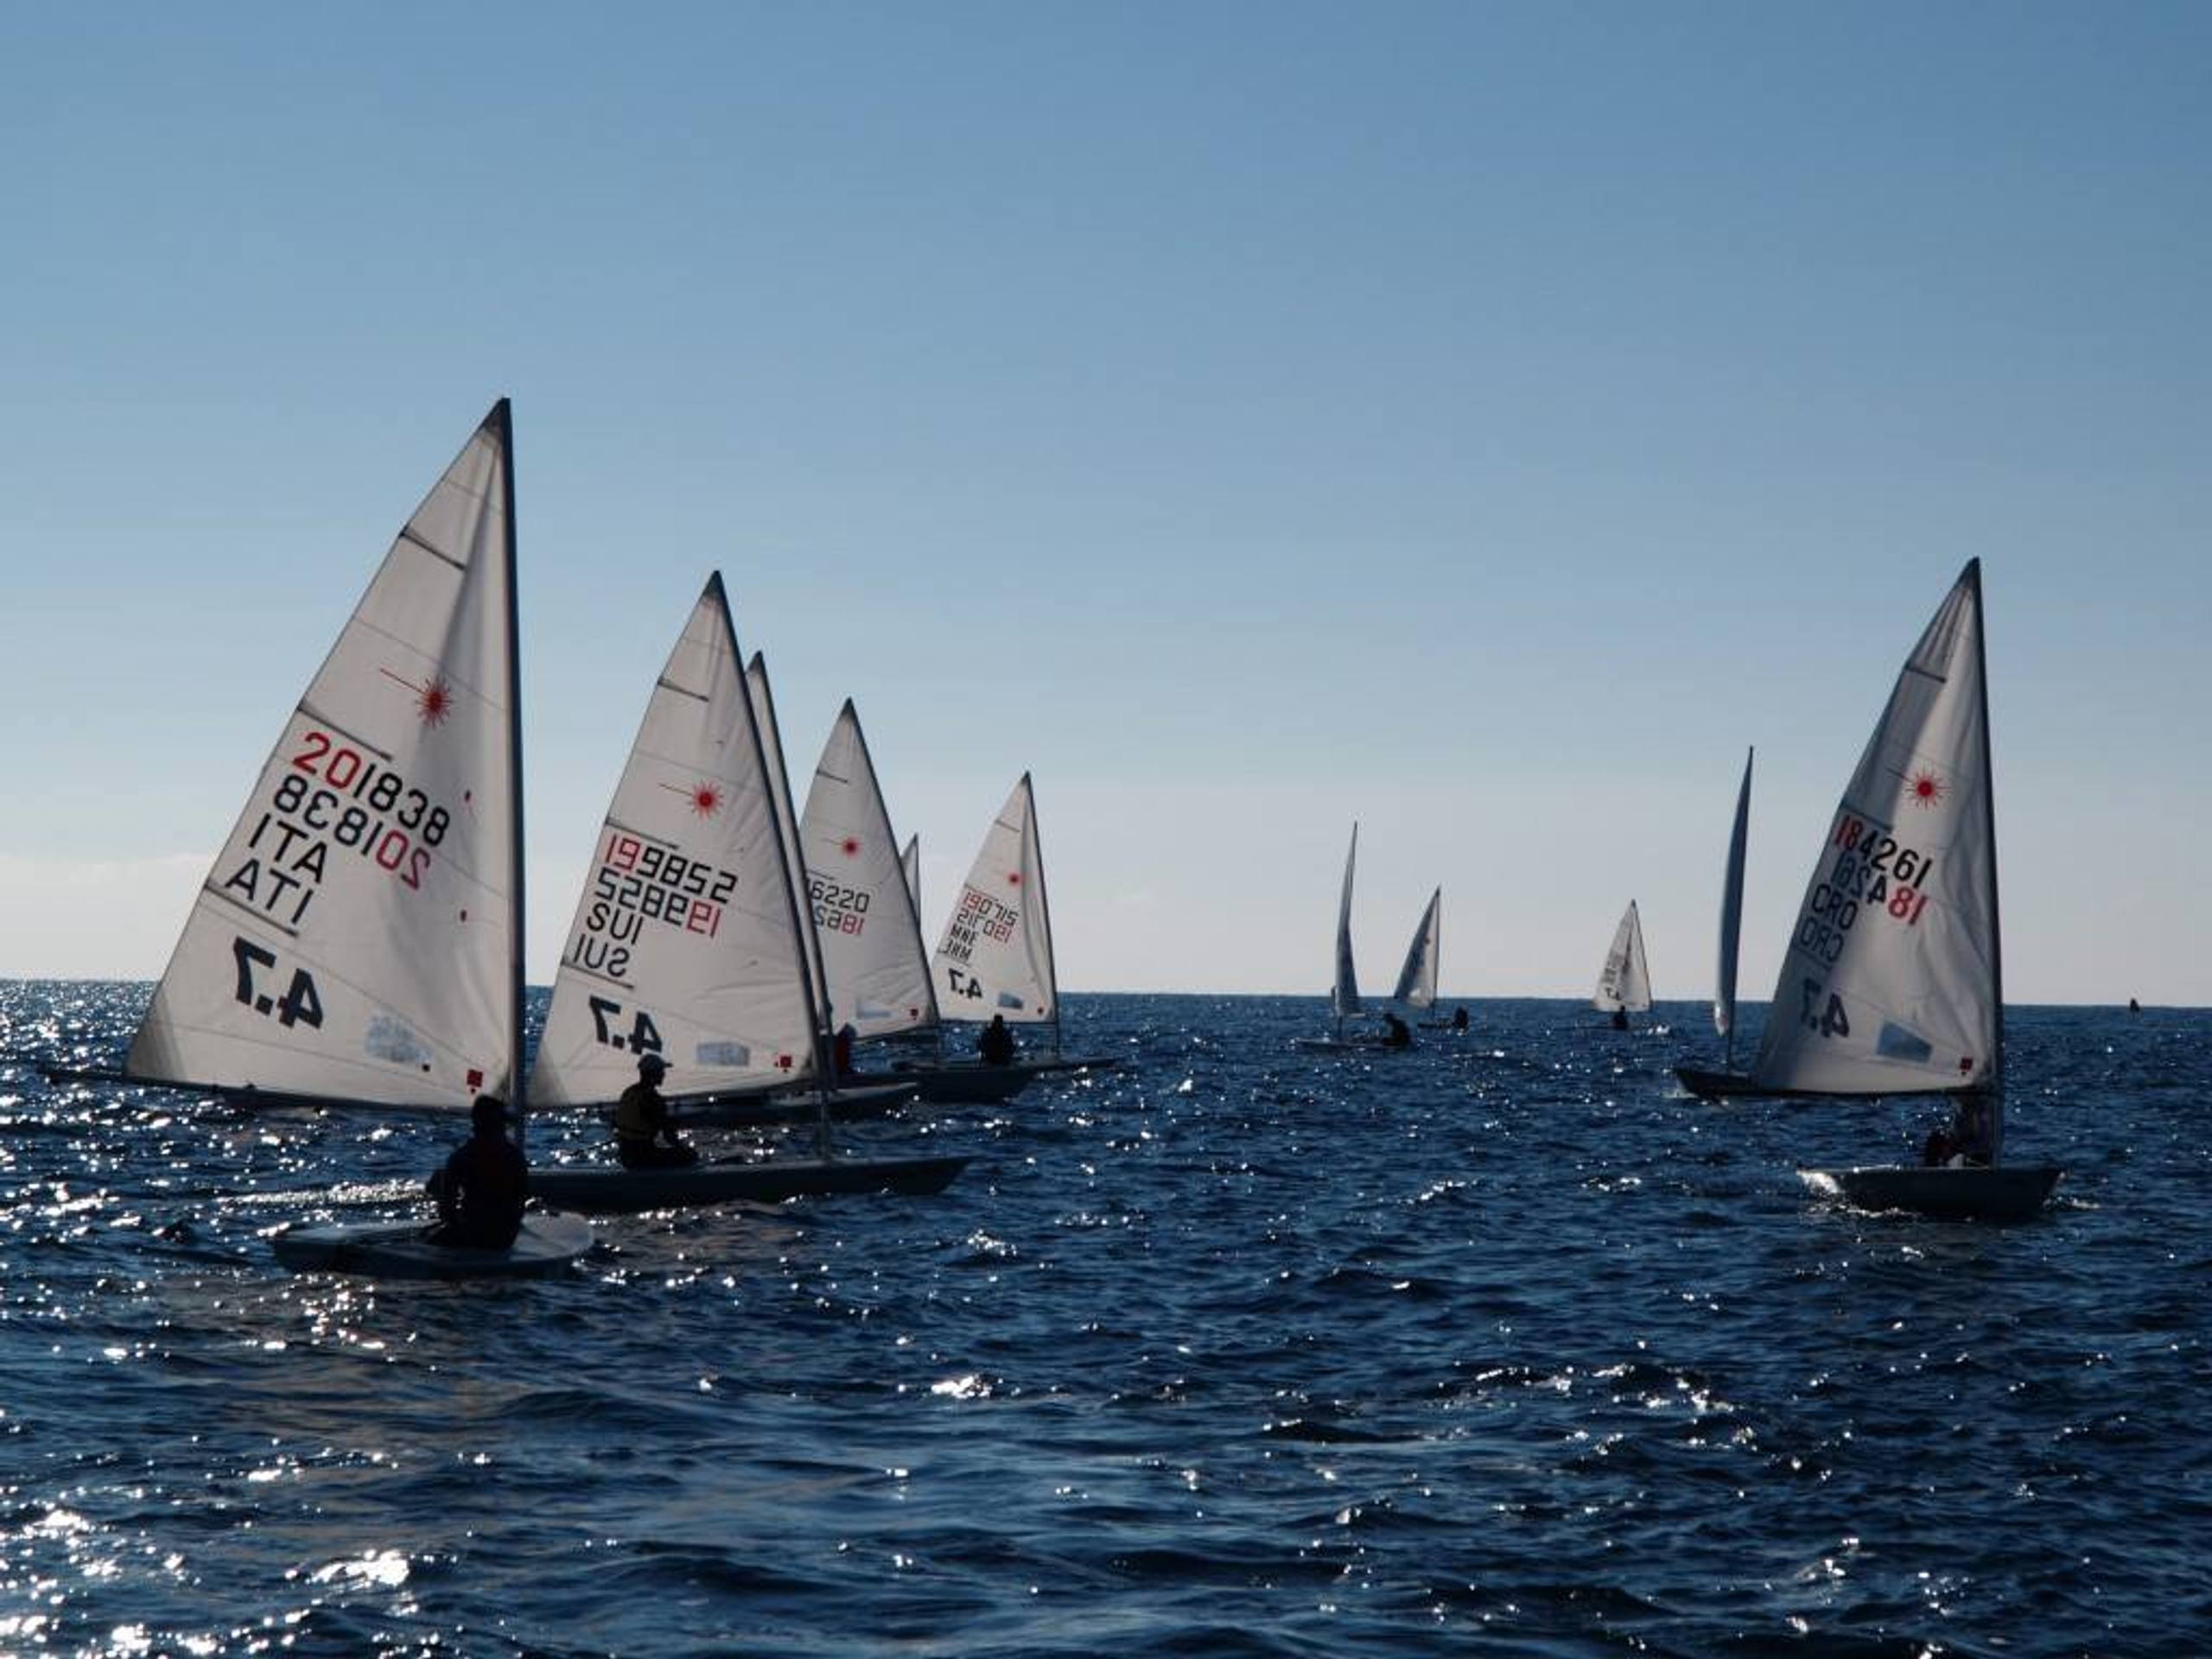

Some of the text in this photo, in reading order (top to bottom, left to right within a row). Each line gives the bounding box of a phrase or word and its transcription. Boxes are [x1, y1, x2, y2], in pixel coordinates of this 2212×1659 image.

[292, 731, 450, 848] 201838
[247, 813, 328, 884] ITA
[606, 834, 739, 905] 199852
[1834, 815, 1933, 889] 184261
[586, 903, 645, 945] SUI
[810, 880, 870, 913] 6220
[1811, 883, 1859, 931] CRO
